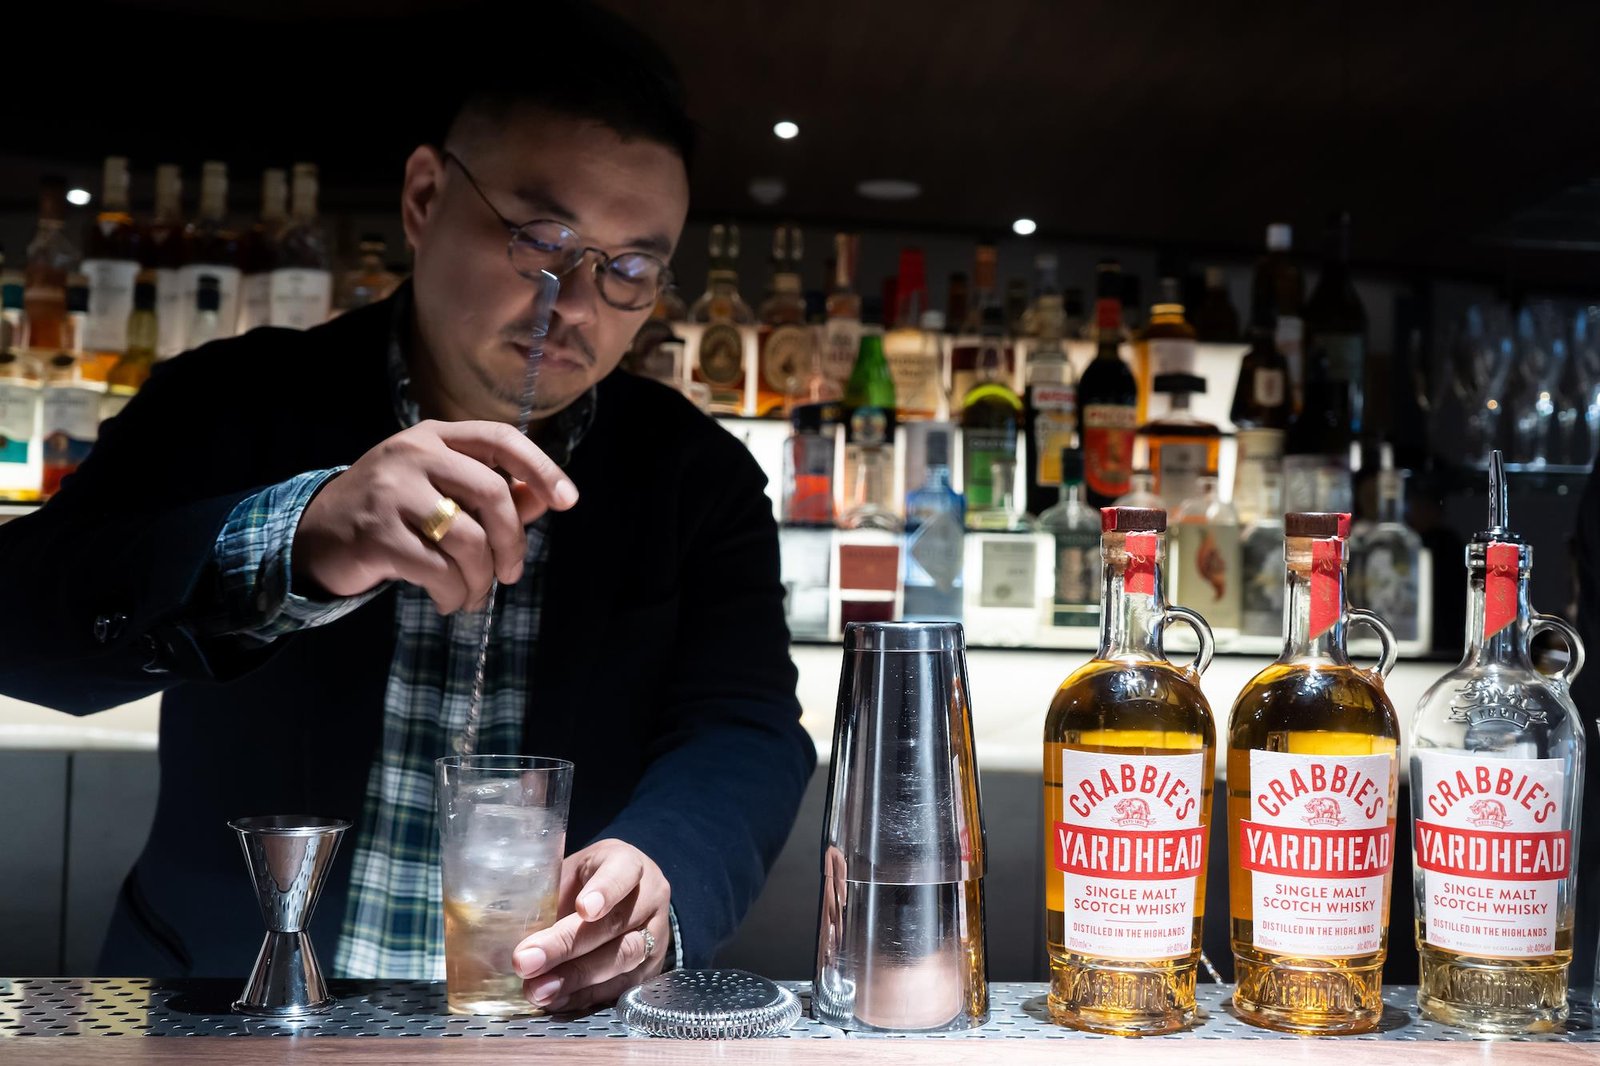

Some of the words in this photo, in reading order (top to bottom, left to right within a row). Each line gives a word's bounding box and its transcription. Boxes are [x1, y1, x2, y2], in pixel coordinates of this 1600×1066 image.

[1069, 763, 1196, 821] CRABBIE'S
[1257, 763, 1384, 821] CRABBIE'S
[1428, 765, 1557, 824] CRABBIE'S
[1058, 828, 1204, 873] YARDHEAD
[1246, 827, 1390, 872] YARDHEAD
[1419, 826, 1566, 874] YARDHEAD
[1085, 885, 1137, 900] SINGLE
[1142, 887, 1177, 901] MALT
[1275, 883, 1328, 898] SINGLE
[1333, 886, 1367, 899] MALT
[1444, 882, 1494, 899] SINGLE
[1499, 888, 1537, 901] MALT
[1074, 898, 1130, 915] SCOTCH
[1135, 901, 1187, 916] WHISKY
[1263, 896, 1321, 913] SCOTCH
[1326, 899, 1376, 914] WHISKY
[1433, 894, 1487, 913] SCOTCH
[1493, 902, 1548, 915] WHISKY
[1073, 922, 1113, 937] DISTILLED
[1114, 928, 1124, 938] IN
[1126, 928, 1142, 938] THE
[1143, 926, 1186, 939] HIGHLANDS
[1262, 920, 1304, 935] DISTILLED
[1305, 926, 1315, 936] IN
[1317, 926, 1333, 936] THE
[1334, 924, 1375, 936] HIGHLANDS
[1433, 918, 1470, 934] DISTILLED
[1472, 925, 1481, 935] IN
[1484, 926, 1499, 937] THE
[1501, 927, 1548, 938] HIGHLANDS
